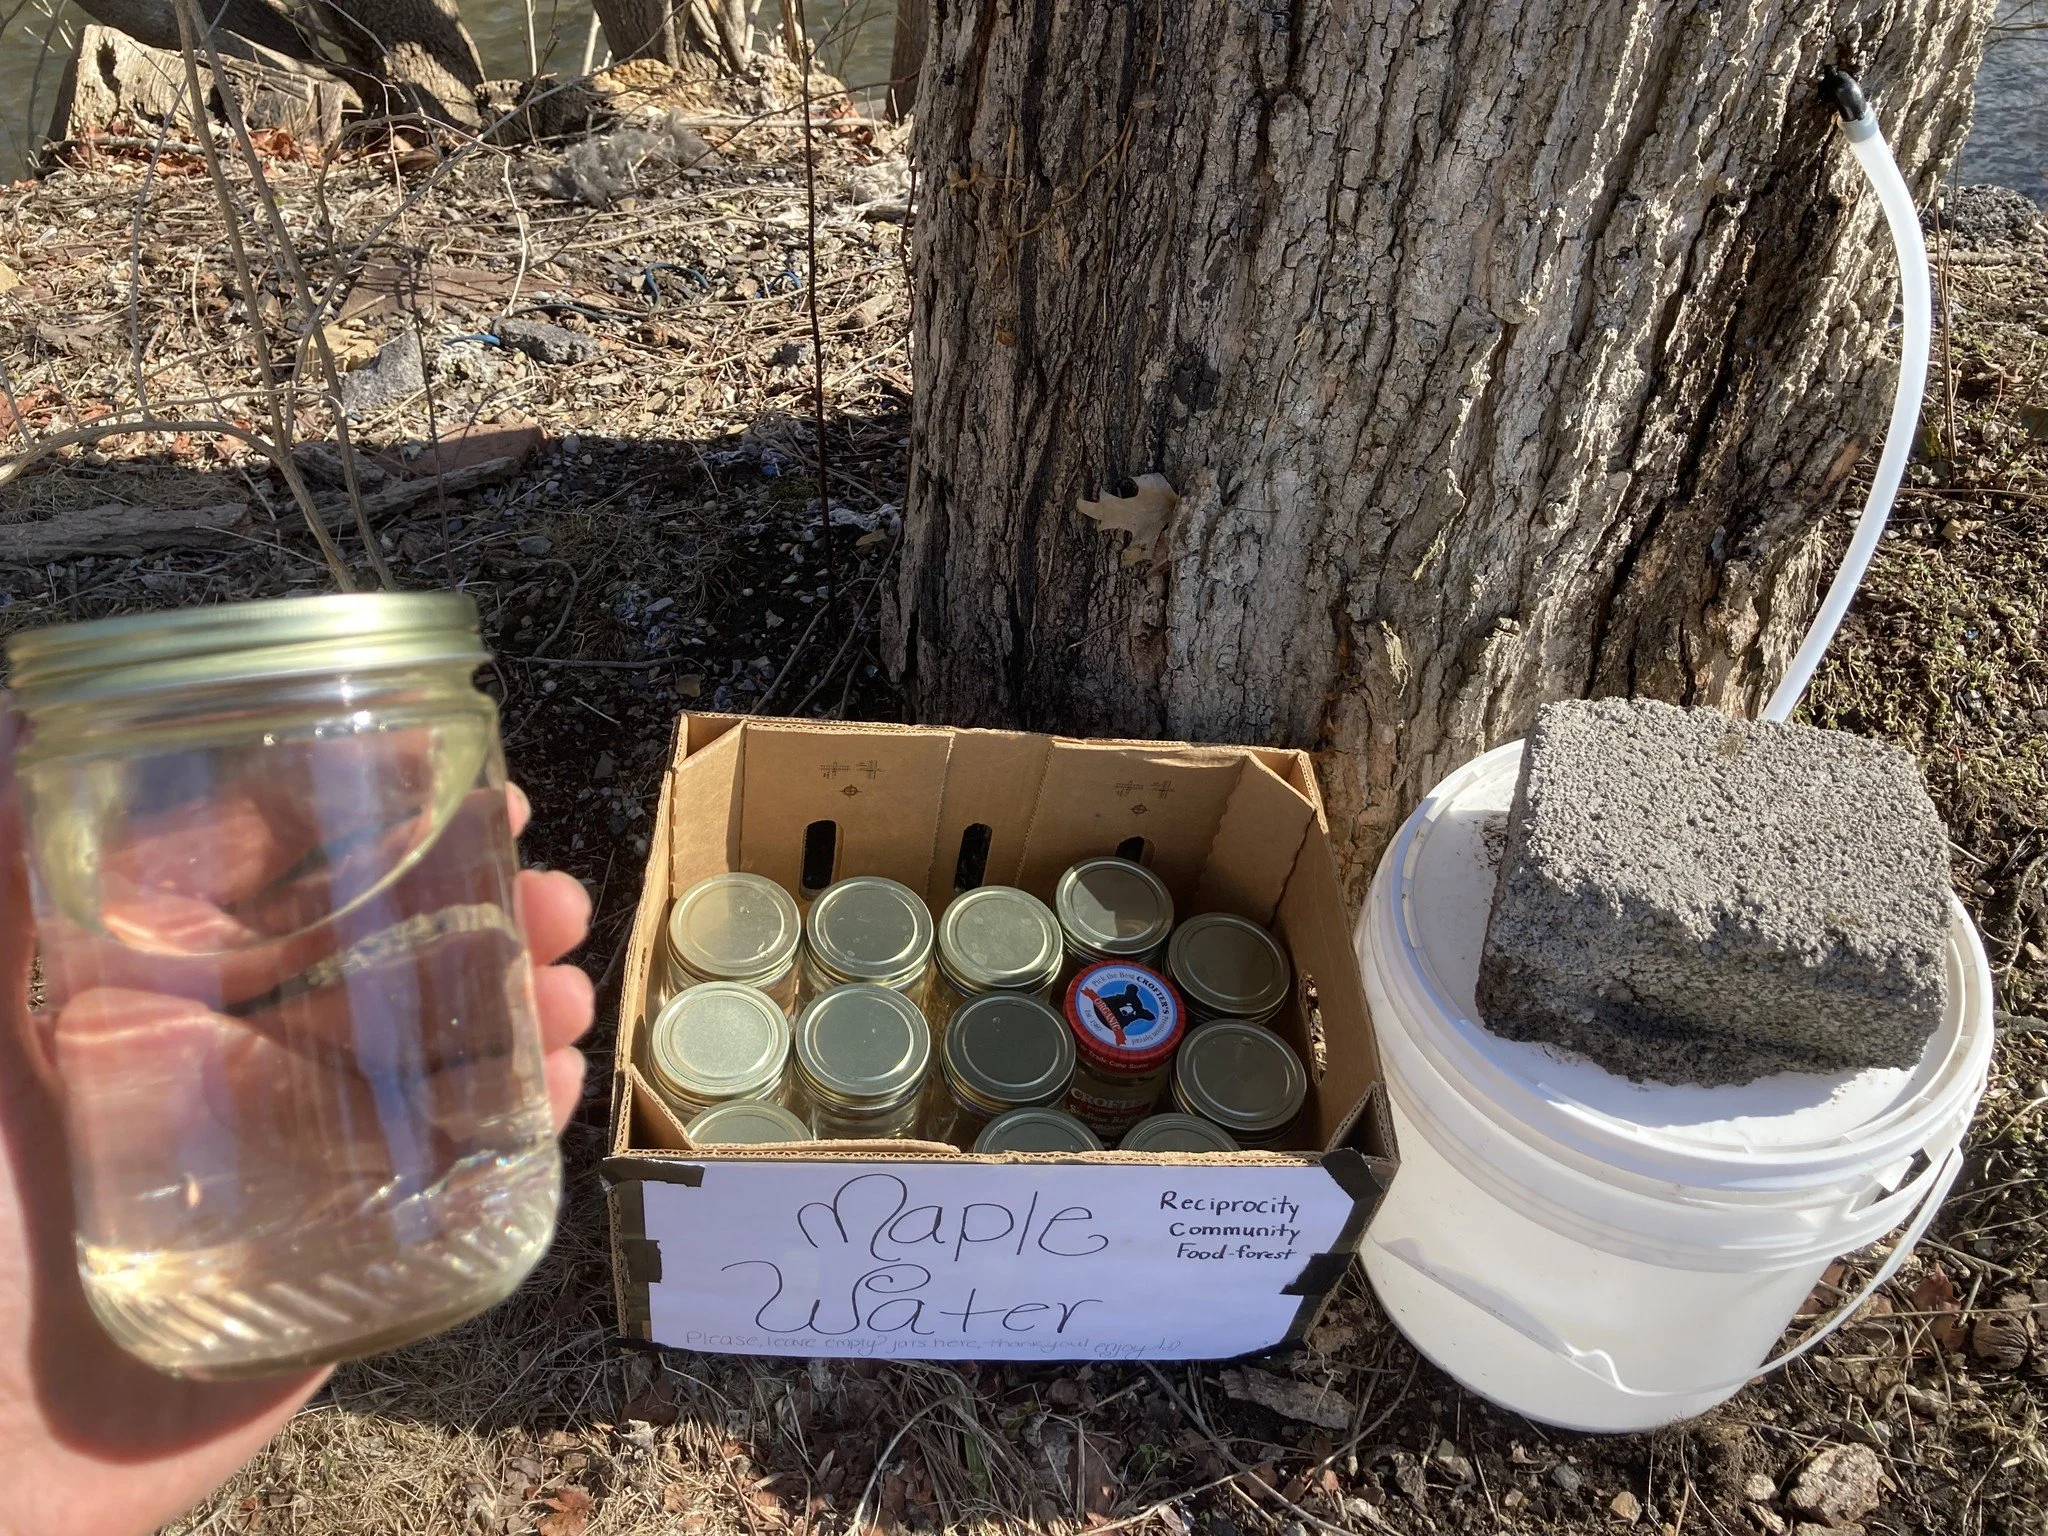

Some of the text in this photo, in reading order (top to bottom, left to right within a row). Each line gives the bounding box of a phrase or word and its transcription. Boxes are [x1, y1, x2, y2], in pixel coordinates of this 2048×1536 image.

[1106, 972, 1117, 980] the
[1136, 975, 1169, 1015] CROFTER'S
[1094, 997, 1120, 1029] ORGANIC
[797, 1173, 1109, 1262] Maple
[1159, 1190, 1300, 1224] Reciprocity
[1168, 1221, 1301, 1246] Community
[1176, 1242, 1298, 1260] Food-forest
[721, 1260, 1104, 1335] Water
